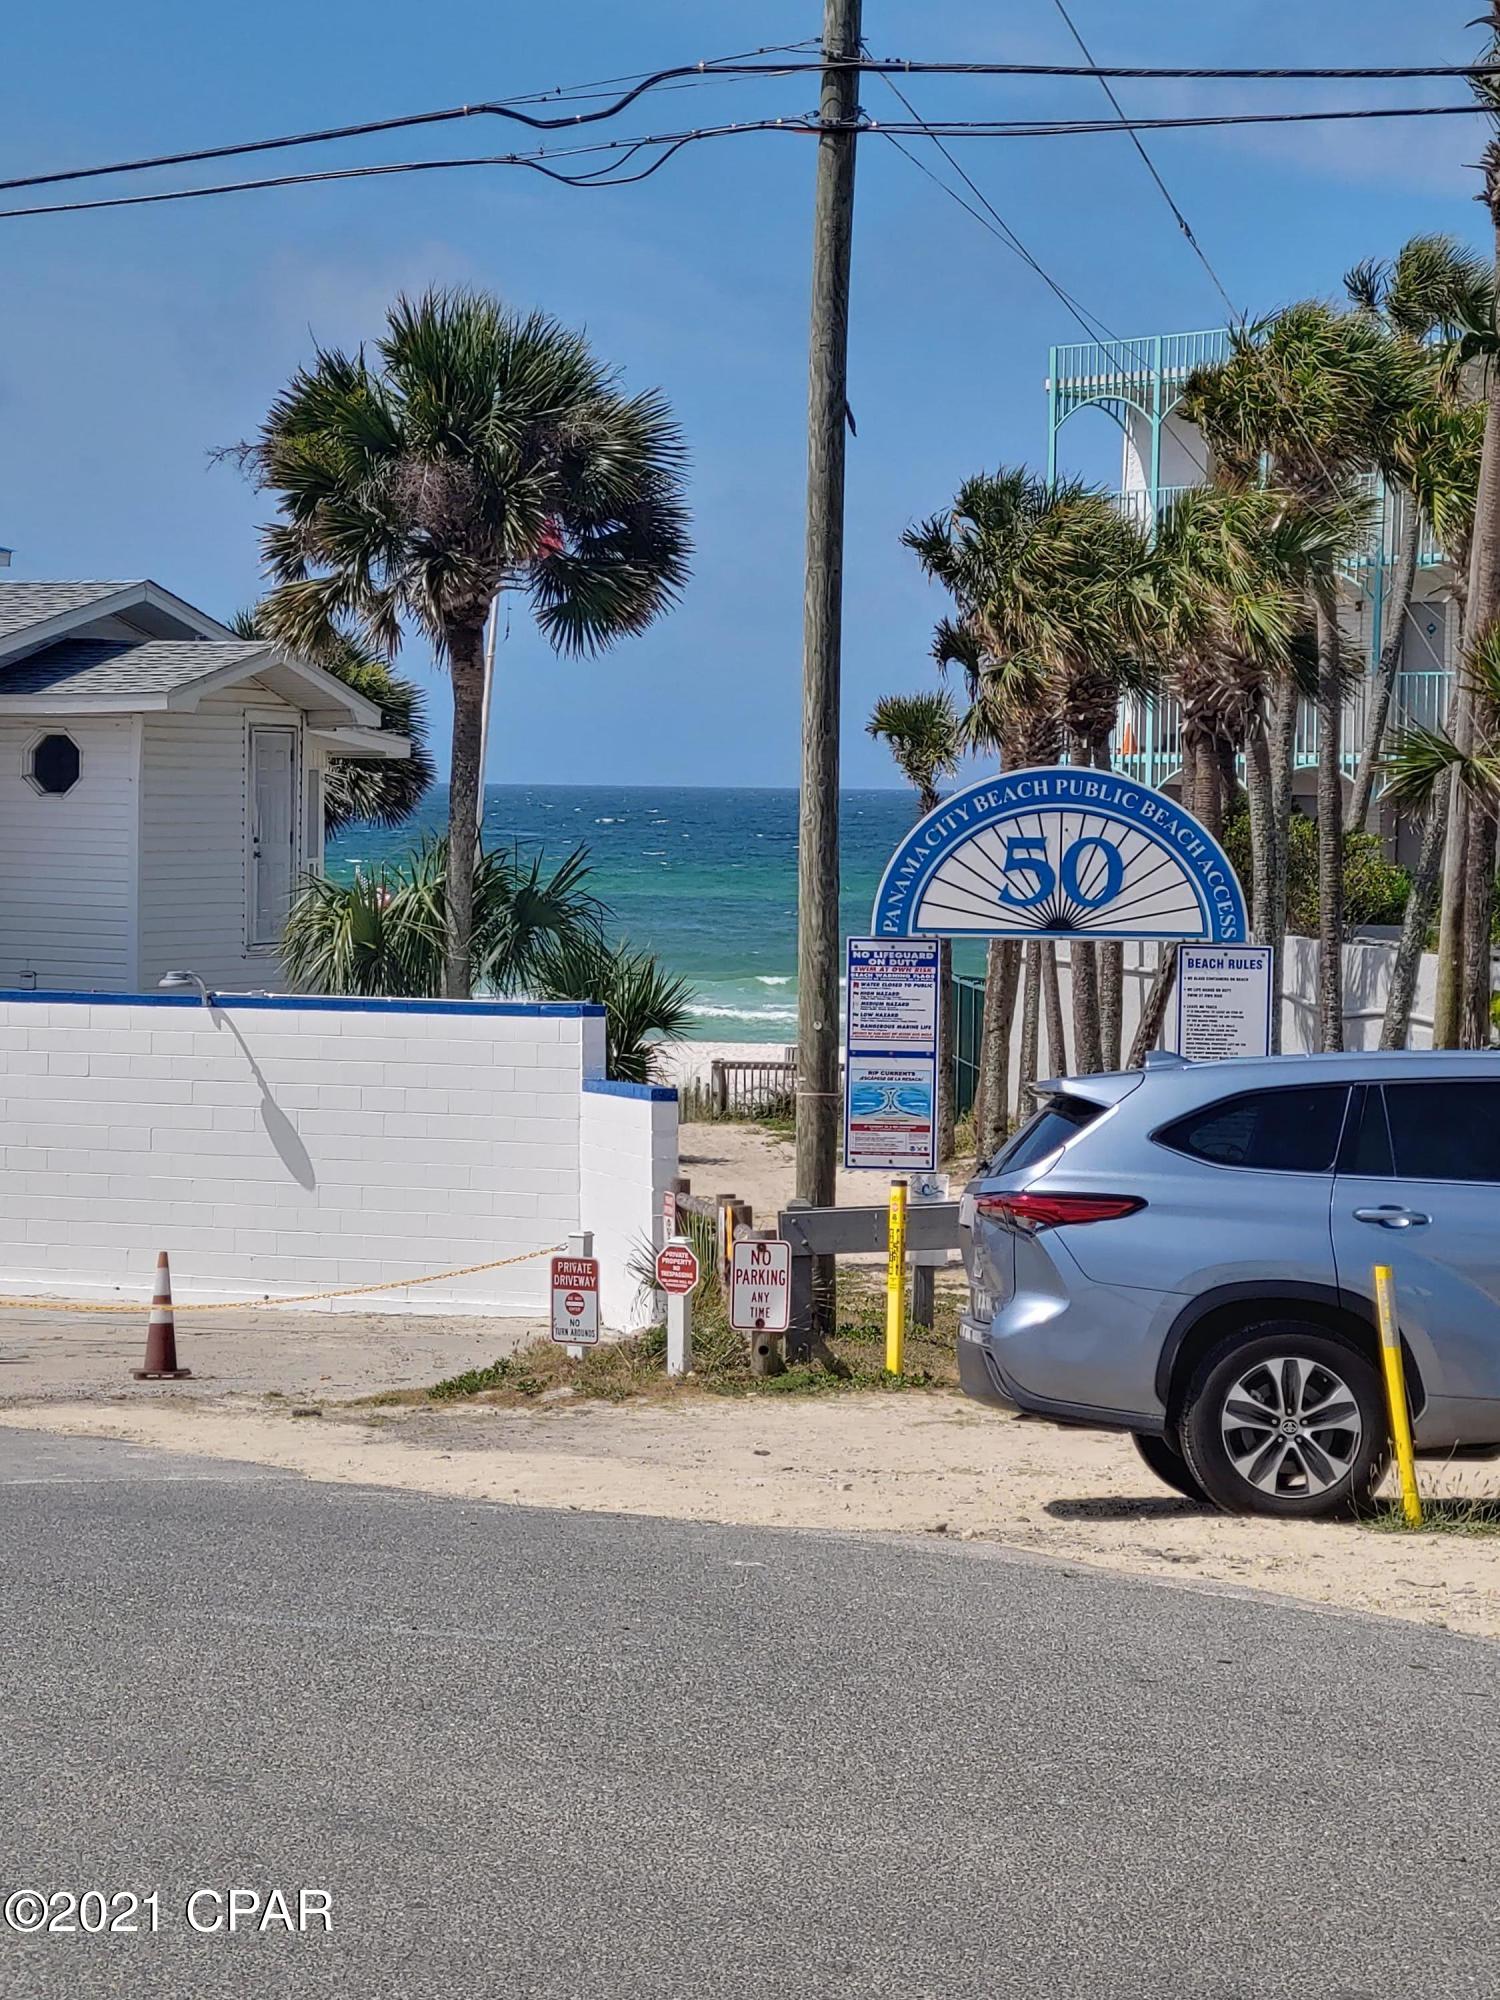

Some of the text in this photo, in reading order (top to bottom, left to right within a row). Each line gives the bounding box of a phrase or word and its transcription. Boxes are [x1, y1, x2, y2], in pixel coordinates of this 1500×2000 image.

[882, 779, 1237, 939] PANAMA CITY BEACH PUBLIC BEACH ACCESS
[998, 836, 1123, 908] 50
[852, 951, 934, 960] NO LIFEGUARD
[868, 958, 919, 966] ON DUTY
[1187, 958, 1263, 970] BEACH RULES
[665, 1251, 689, 1259] PRIVATE
[751, 1249, 772, 1266] NO
[557, 1261, 593, 1274] PRIVATE
[661, 1257, 692, 1266] PROPERTY
[554, 1274, 597, 1288] DRIVEWAY
[735, 1268, 786, 1286] PARKING
[751, 1291, 770, 1303] ANY
[750, 1306, 771, 1319] TIME
[569, 1318, 581, 1327] NO
[555, 1328, 596, 1338] TURN AROUNDS
